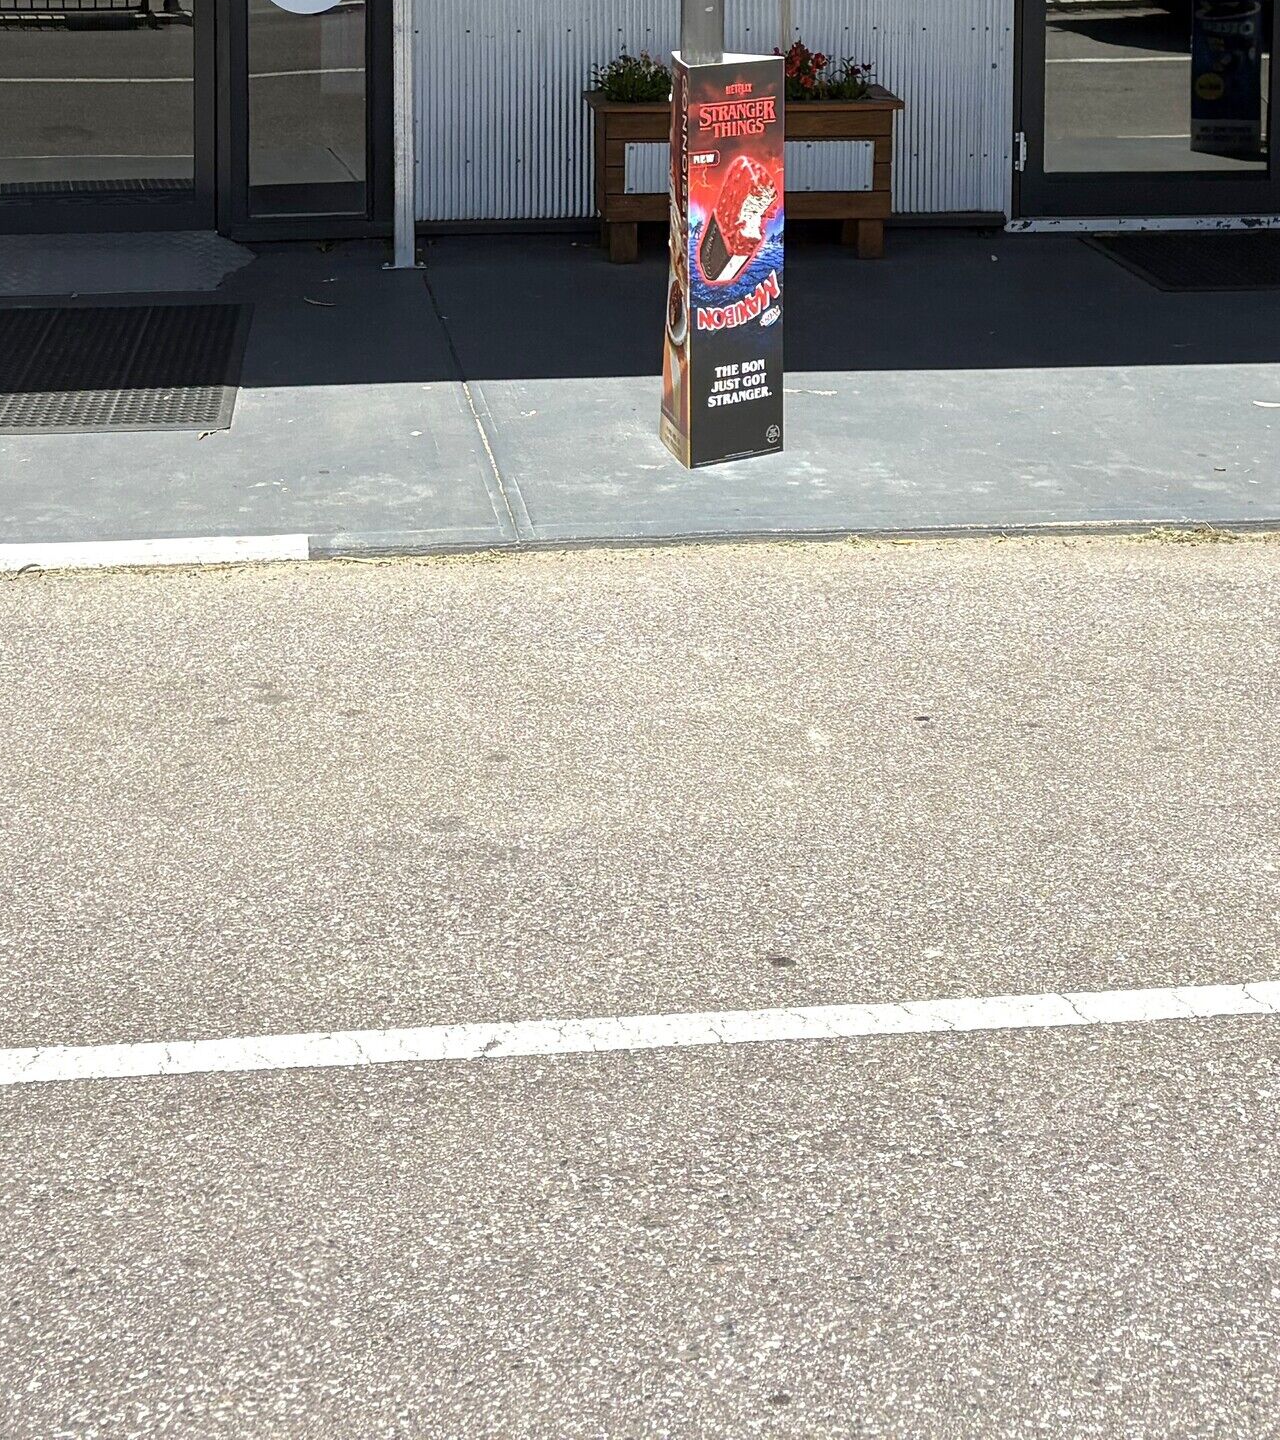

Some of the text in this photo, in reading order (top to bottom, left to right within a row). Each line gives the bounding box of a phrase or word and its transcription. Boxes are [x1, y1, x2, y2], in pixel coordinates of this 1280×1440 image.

[726, 83, 752, 95] NETFLIX
[700, 100, 776, 127] STRANGER
[713, 118, 765, 138] THINGS
[693, 154, 715, 164] NEW
[697, 269, 780, 330] MAXIBON
[715, 359, 765, 378] THE BON
[711, 373, 767, 393] JUST GOT
[708, 386, 772, 407] STRANGER.
